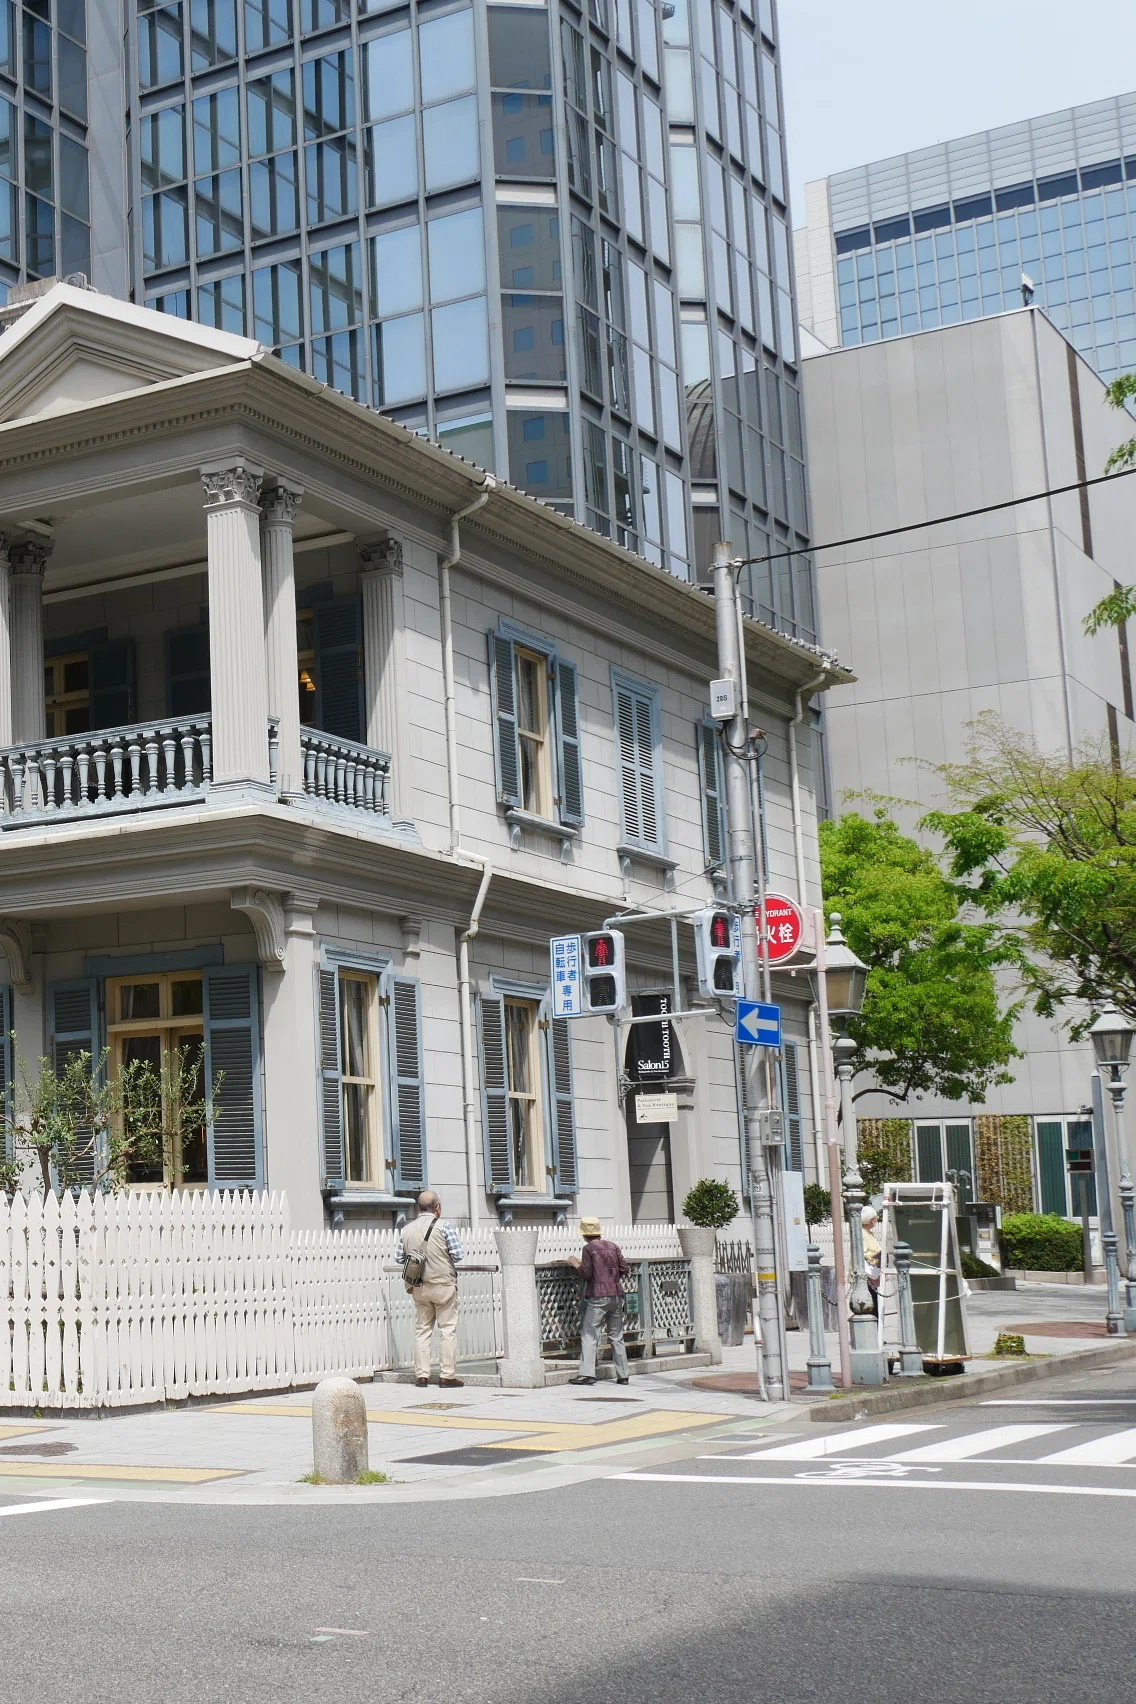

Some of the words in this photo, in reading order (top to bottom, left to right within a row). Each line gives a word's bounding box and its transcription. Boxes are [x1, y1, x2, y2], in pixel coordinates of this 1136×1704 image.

[765, 908, 793, 918] YDRANT
[756, 922, 795, 945] 火栓
[555, 943, 566, 982] 自転車
[566, 942, 577, 981] 歩行者
[562, 984, 572, 1011] 専用
[660, 998, 669, 1028] TOOH
[662, 1029, 671, 1059] TOOTH
[638, 1060, 670, 1070] Salon15
